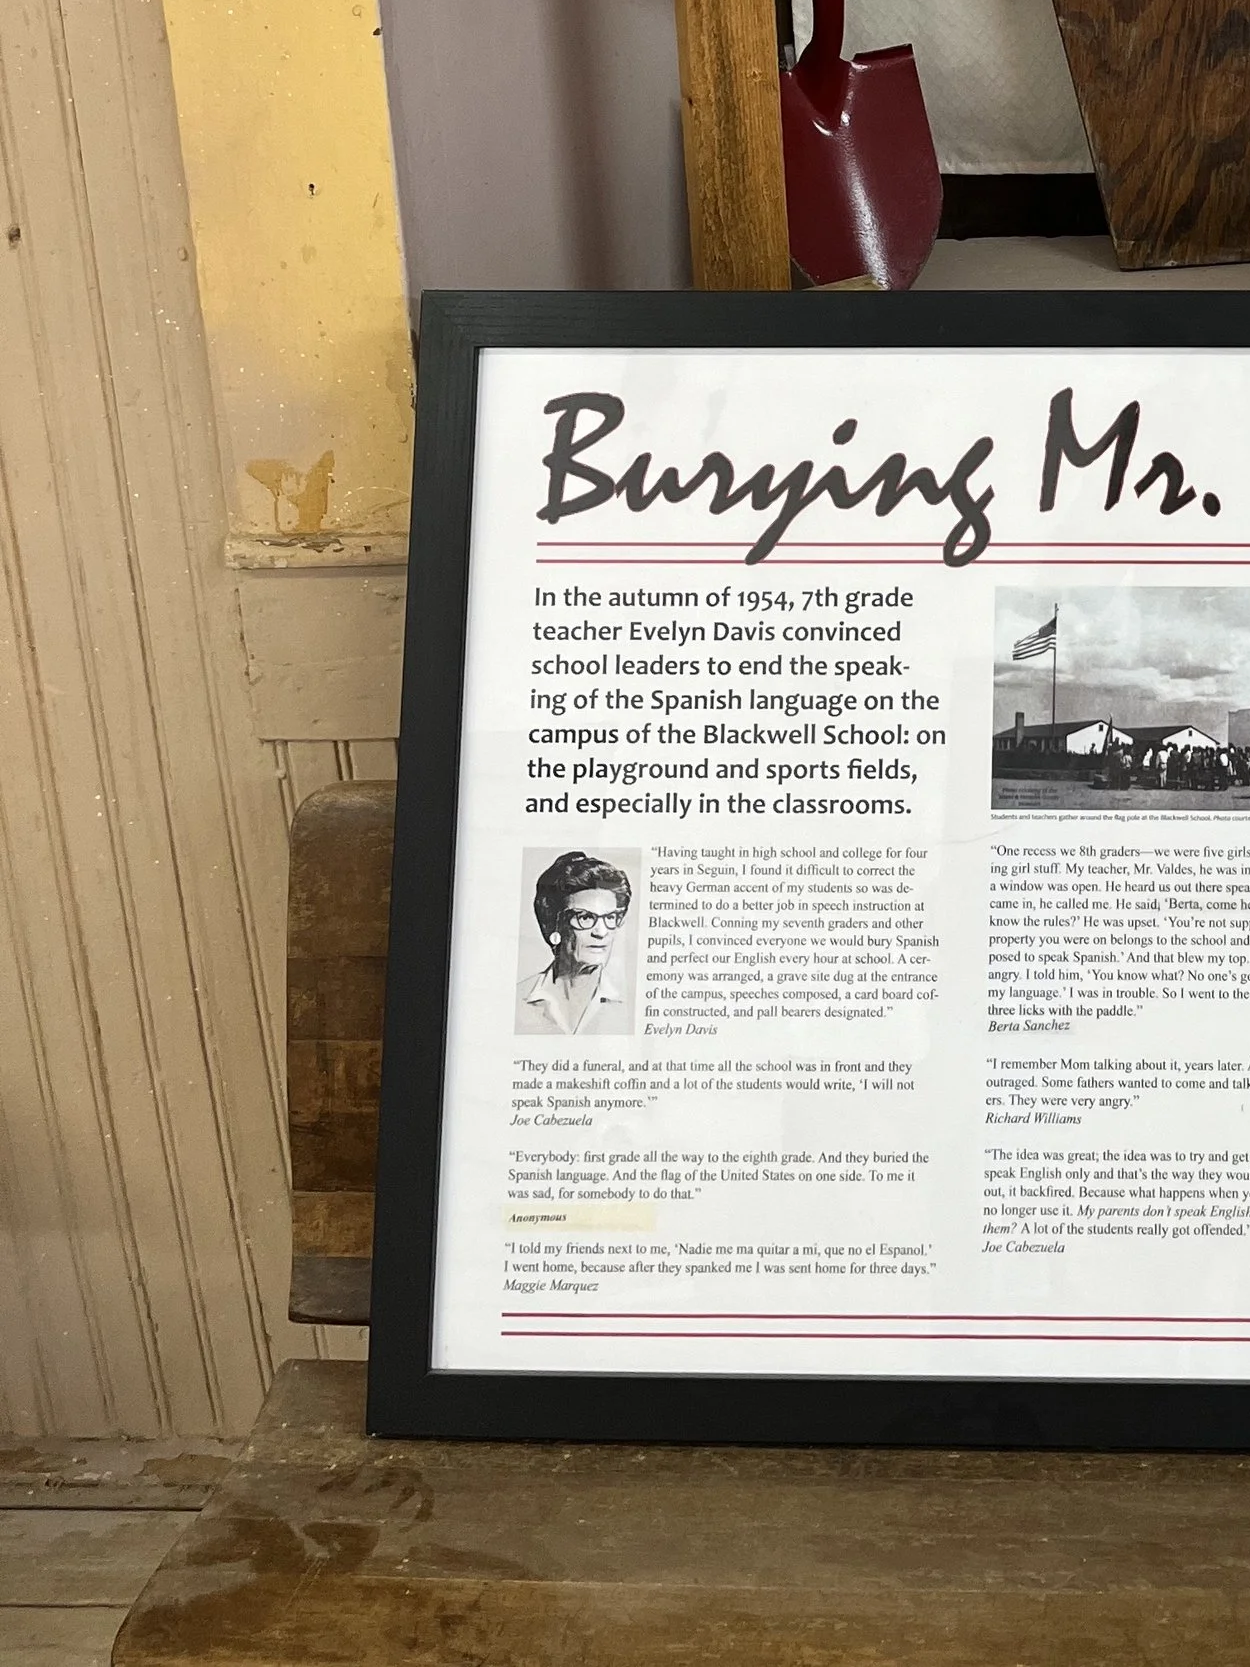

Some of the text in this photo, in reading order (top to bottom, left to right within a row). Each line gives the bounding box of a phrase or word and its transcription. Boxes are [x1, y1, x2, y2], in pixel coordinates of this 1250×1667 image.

[536, 392, 995, 568] Burying
[1040, 387, 1221, 515] Mr.
[535, 585, 913, 614] In the autumn of 1954, 7th grade
[532, 619, 901, 647] teacher Evelyn Davis convinced
[531, 653, 910, 682] school leaders to end the speak-
[530, 687, 939, 717] ing of the Spanish language on the
[528, 722, 946, 750] campus of the Blackwell School: on
[526, 756, 917, 785] the playground and sports fields,
[525, 791, 911, 819] and especially in the classrooms.
[987, 1003, 1016, 1016] three
[1018, 1003, 1045, 1016] licks
[1048, 1004, 1073, 1016] with
[1076, 1004, 1093, 1016] the
[643, 1022, 718, 1038] Evelyn Davis
[987, 1018, 1070, 1032] Berta Sanchez
[511, 1095, 543, 1111] speak
[546, 1095, 591, 1111] Spanish
[509, 1113, 593, 1126] Joe Cabezuela
[984, 1111, 1082, 1125] Richard Williams
[508, 1213, 567, 1225] Anonymous
[981, 1240, 1065, 1253] Joe Cabezuela
[502, 1278, 599, 1295] Maggie Marquez
